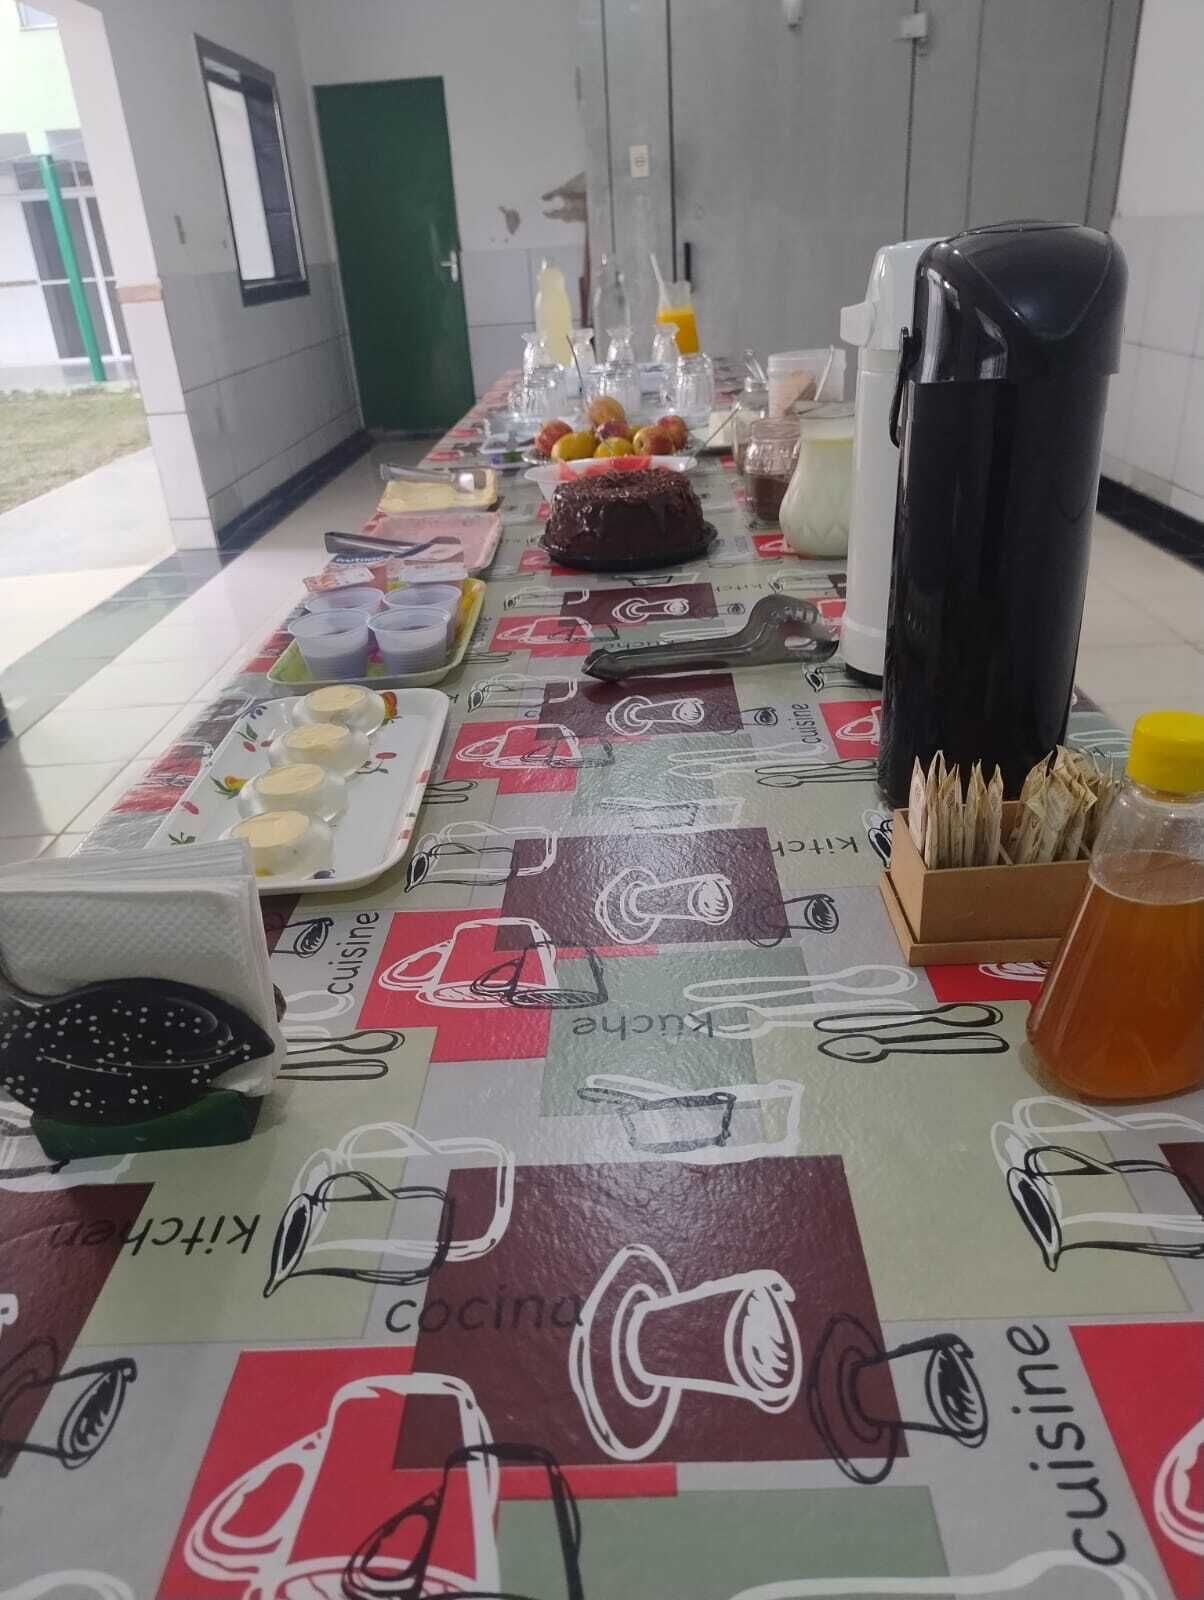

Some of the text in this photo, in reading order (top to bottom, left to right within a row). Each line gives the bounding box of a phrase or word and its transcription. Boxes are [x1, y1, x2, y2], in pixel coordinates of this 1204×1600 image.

[787, 703, 822, 744] cuisine
[327, 911, 379, 995] cuisine
[572, 1012, 714, 1041] küche
[48, 1214, 262, 1257] kitchen
[385, 1284, 585, 1334] cocina
[1006, 1323, 1127, 1567] cuisine
